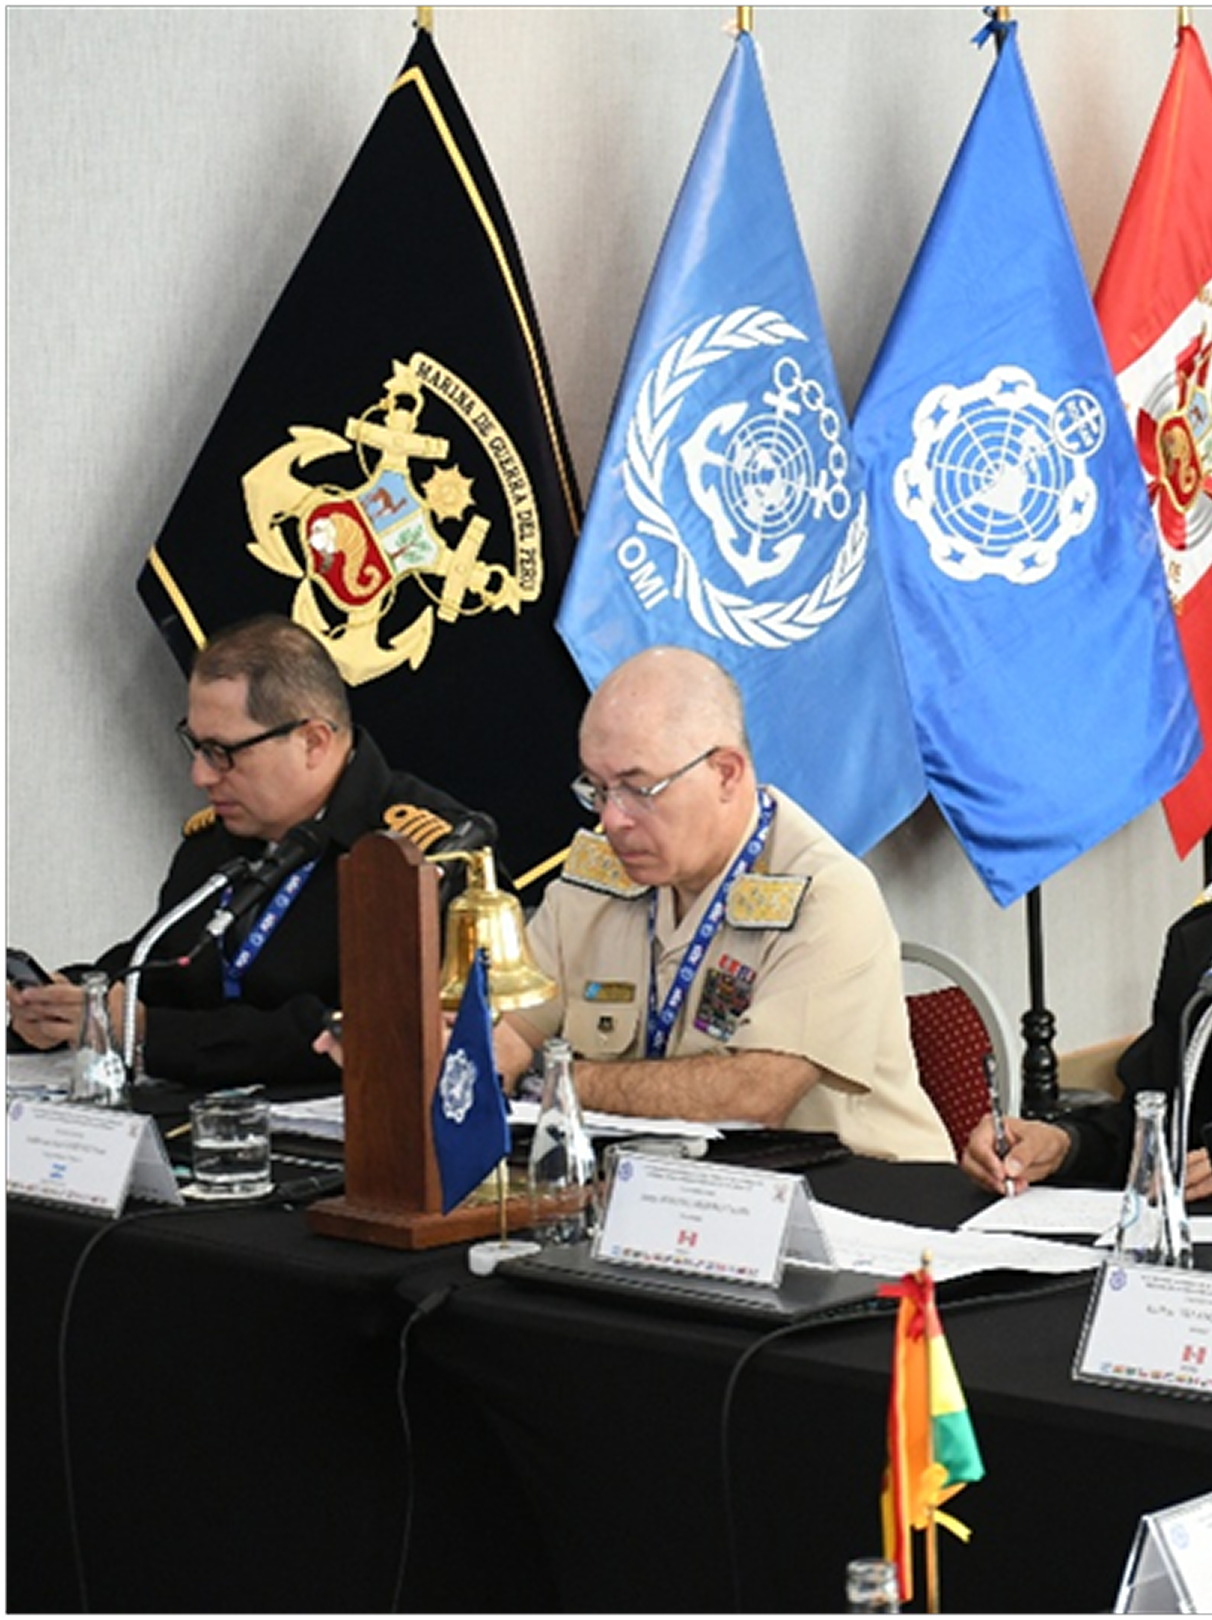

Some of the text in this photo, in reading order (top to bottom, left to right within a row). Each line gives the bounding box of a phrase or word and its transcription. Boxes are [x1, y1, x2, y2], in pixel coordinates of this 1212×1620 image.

[415, 361, 475, 415] MARINA
[473, 410, 493, 438] DE
[488, 436, 527, 505] GUERRA
[516, 509, 535, 541] DEL
[617, 535, 669, 611] OMI
